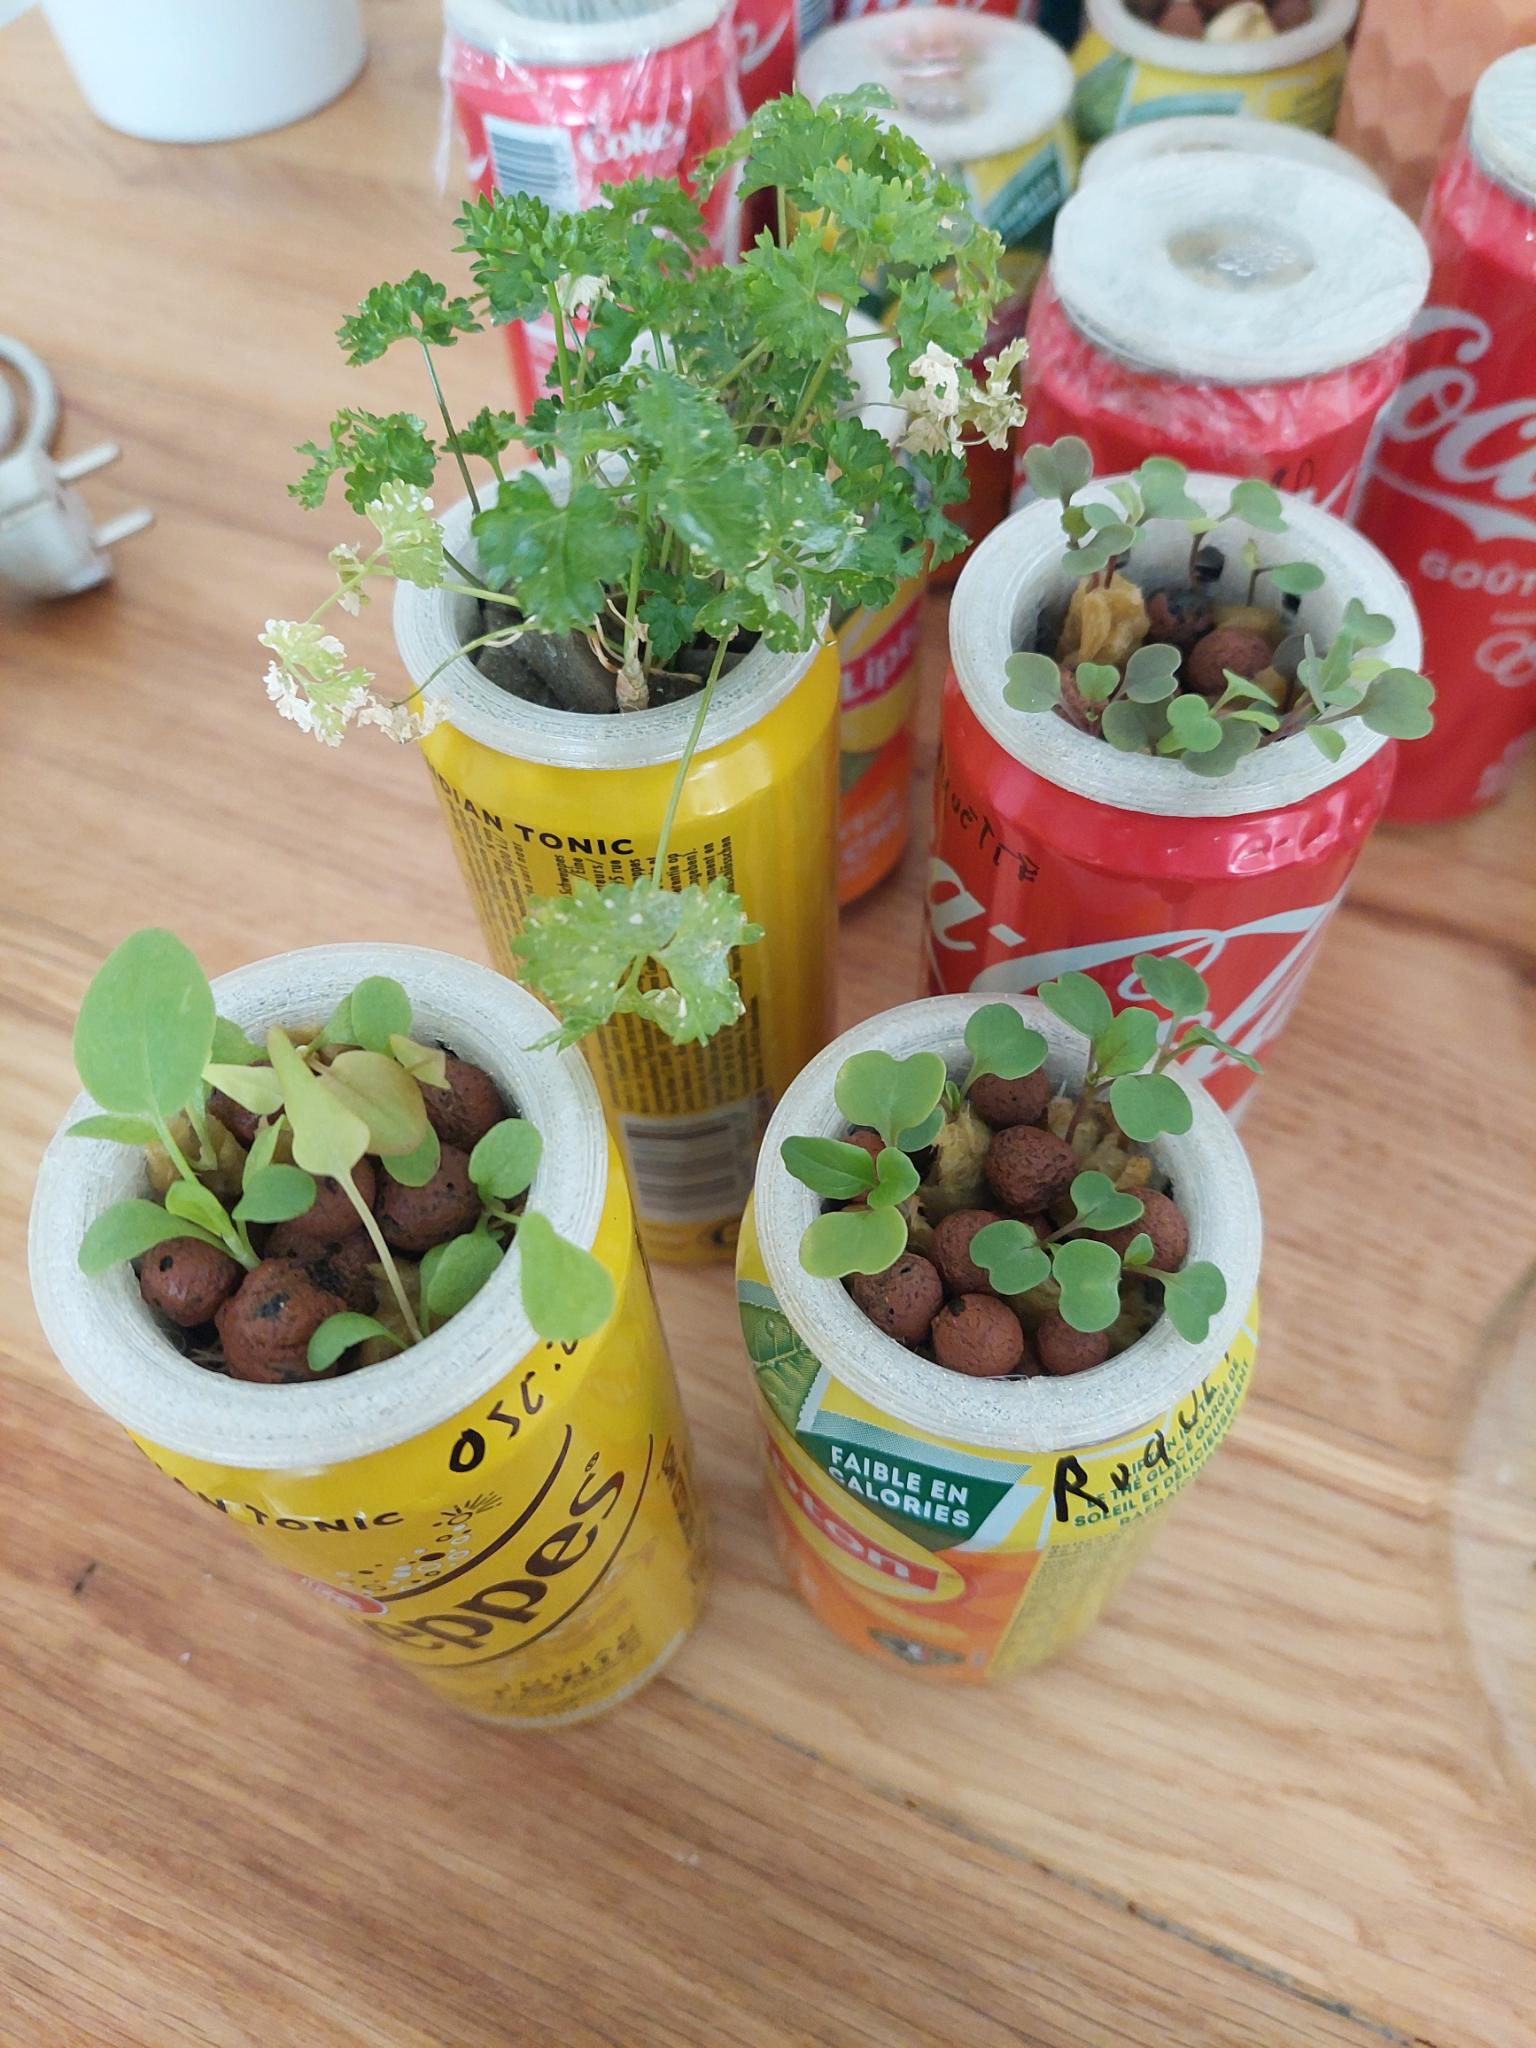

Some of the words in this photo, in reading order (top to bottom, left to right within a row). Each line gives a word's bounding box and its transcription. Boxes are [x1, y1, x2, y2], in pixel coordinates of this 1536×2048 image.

[514, 823, 634, 856] TONIC
[831, 1445, 921, 1493] FAIBLE
[931, 1479, 968, 1506] EN
[245, 1503, 404, 1533] TONIC
[828, 1466, 970, 1528] CALORIES
[1074, 1499, 1137, 1527] SOLEIL
[1141, 1485, 1159, 1504] ET
